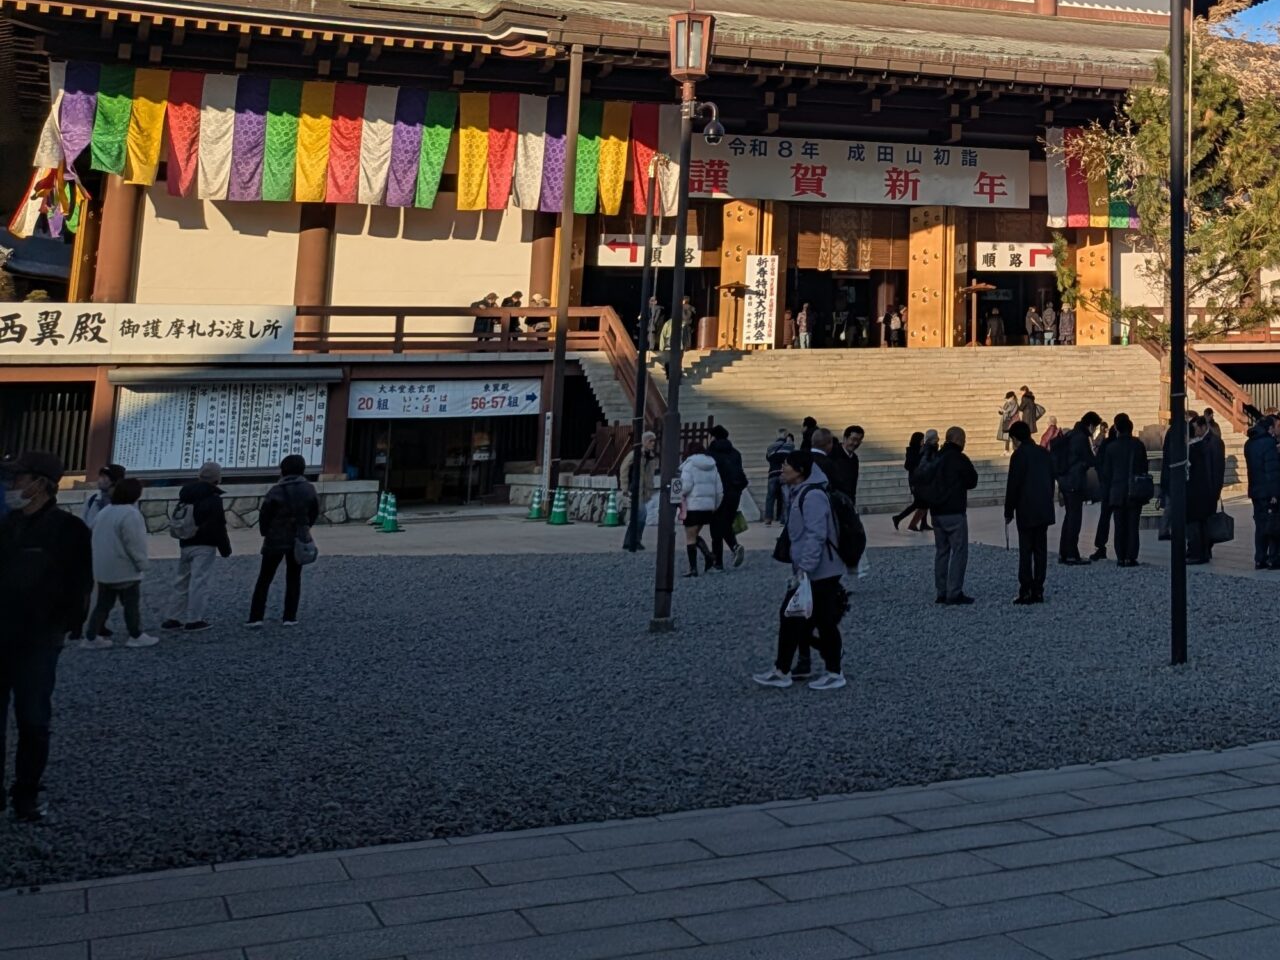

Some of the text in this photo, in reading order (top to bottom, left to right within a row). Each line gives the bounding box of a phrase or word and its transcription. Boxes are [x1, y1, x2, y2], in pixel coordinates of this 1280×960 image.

[728, 138, 978, 167] 令和8年 成田山初詣
[689, 159, 1008, 204] 謹賀新年
[982, 253, 1023, 268] 順路
[753, 257, 769, 341] 新春特別大祈祷会
[0, 310, 108, 346] 西翼殿
[118, 318, 283, 340] 御護摩札お渡し所
[358, 397, 373, 410] 20
